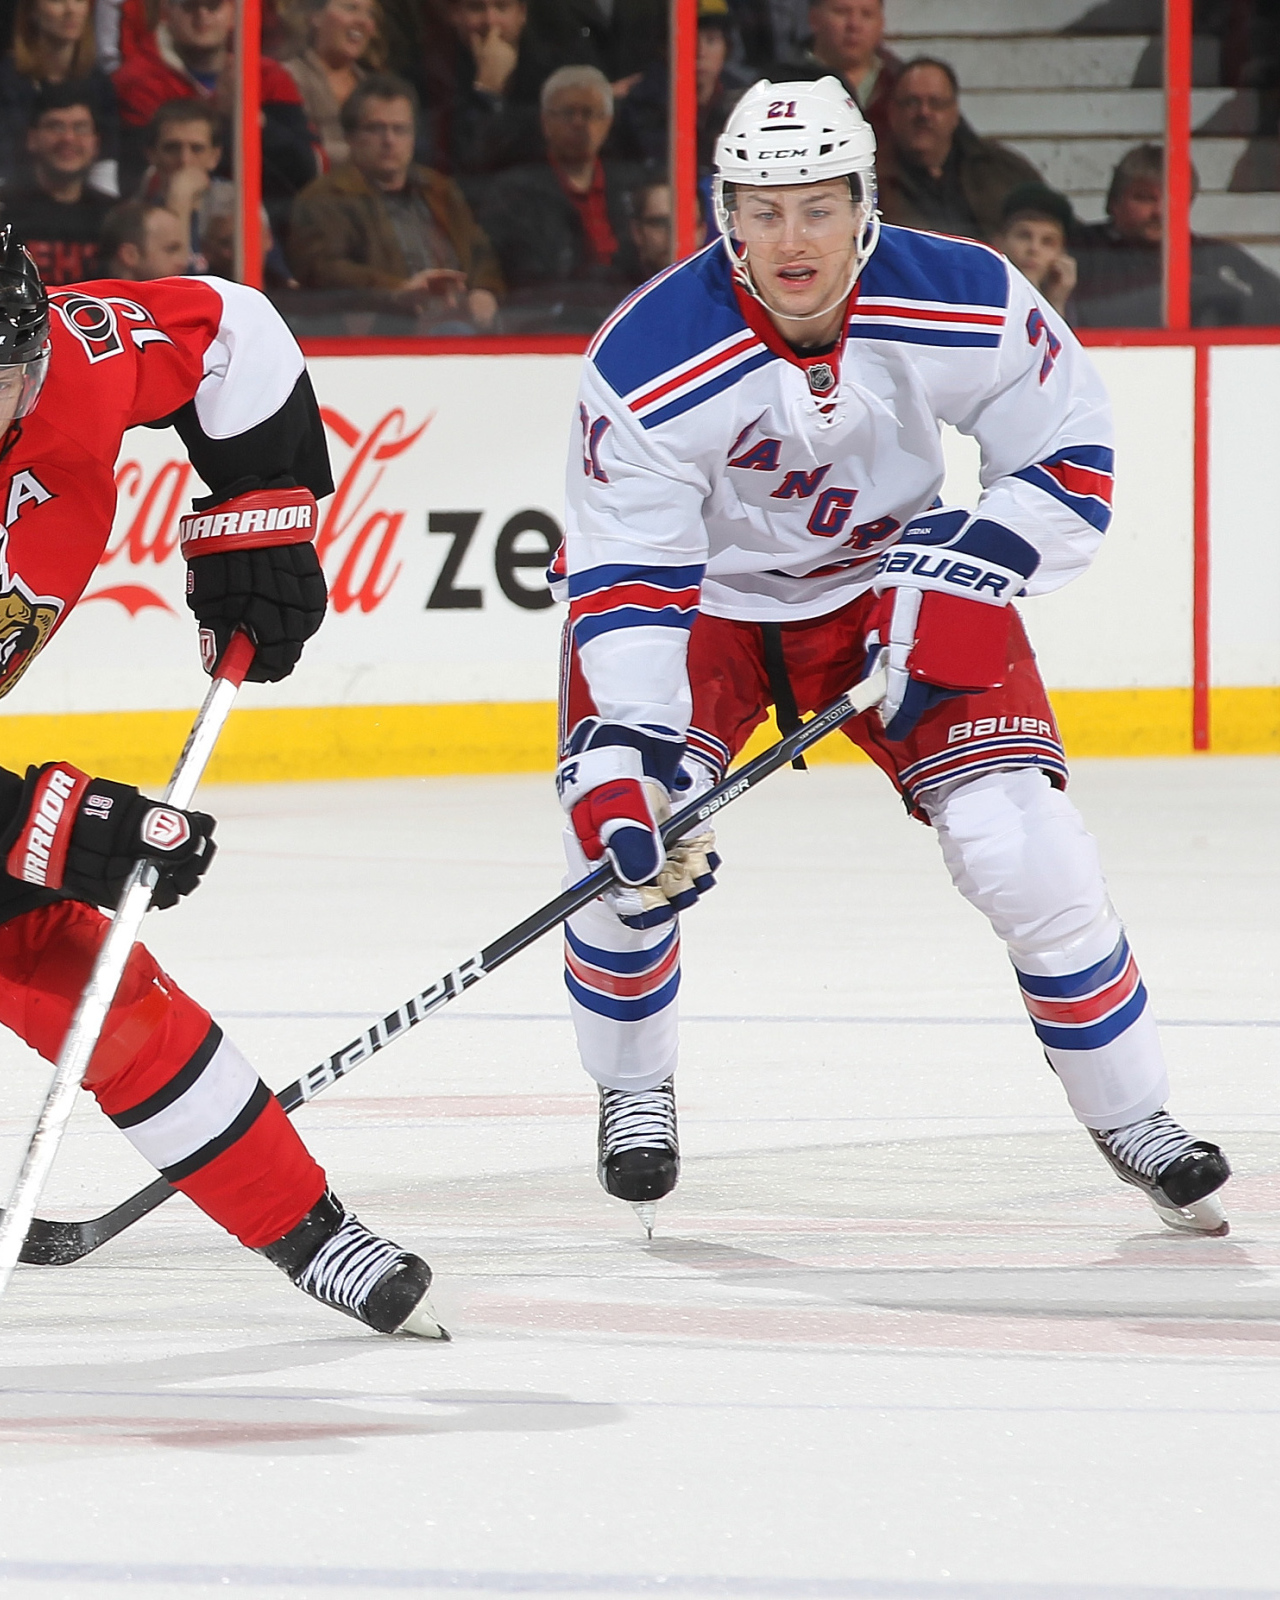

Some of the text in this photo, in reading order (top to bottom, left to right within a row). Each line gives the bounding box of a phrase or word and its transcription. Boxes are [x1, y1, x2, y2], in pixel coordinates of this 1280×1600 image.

[767, 101, 797, 118] 21
[758, 148, 809, 160] CCM
[6, 469, 59, 528] A
[425, 508, 562, 611] ze
[22, 769, 77, 886] ARRIOR
[83, 794, 115, 820] 19
